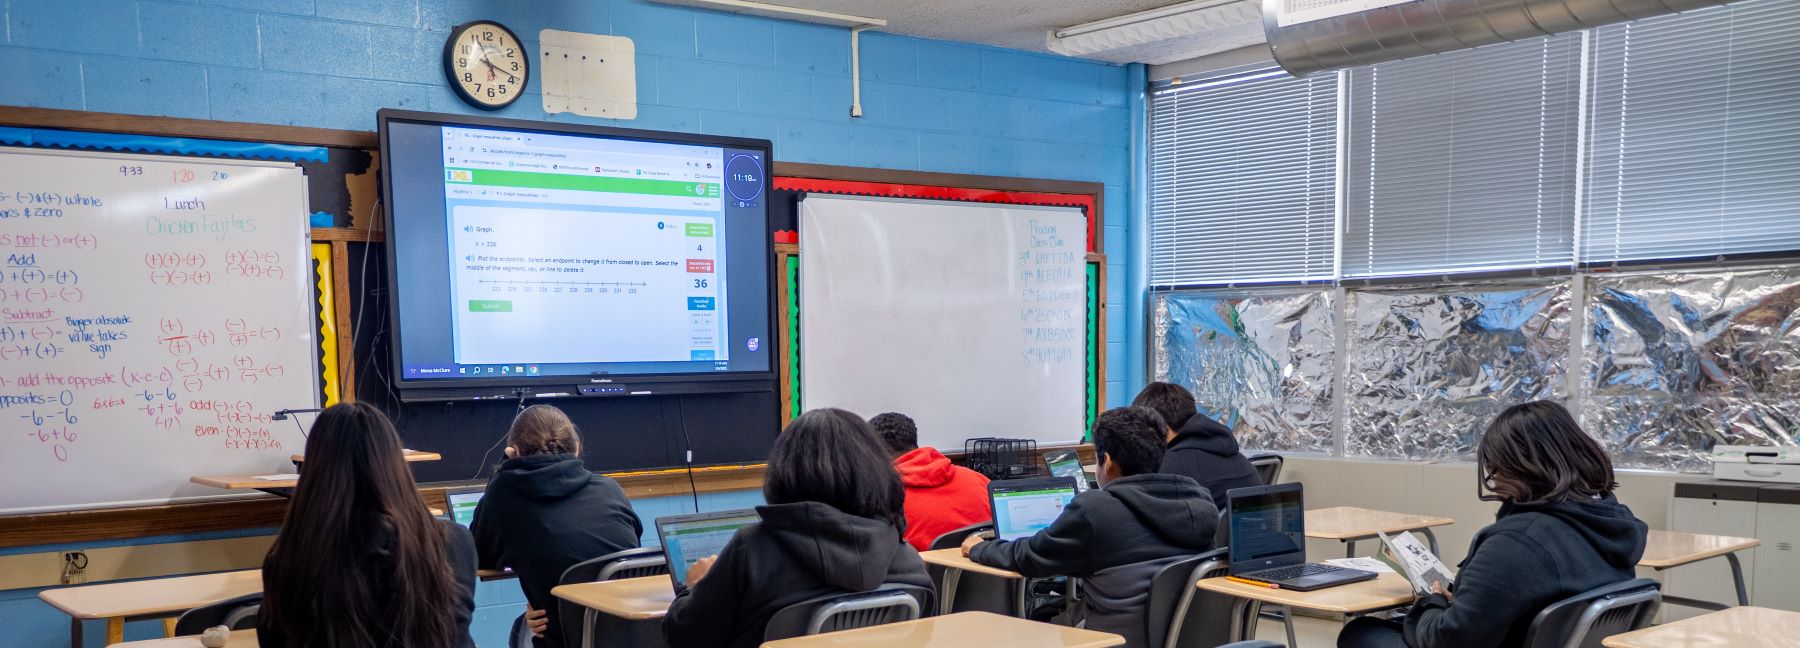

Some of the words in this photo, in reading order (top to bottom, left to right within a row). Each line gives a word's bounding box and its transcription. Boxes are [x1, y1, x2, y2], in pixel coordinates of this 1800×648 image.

[483, 32, 493, 41] 12
[506, 48, 514, 57] 2
[459, 58, 467, 67] 9
[511, 62, 518, 71] 3
[465, 73, 472, 82] 8
[508, 75, 515, 84] 4
[474, 84, 482, 92] 7
[488, 88, 495, 97] 6
[499, 85, 506, 94] 5
[65, 194, 103, 207] whole
[164, 196, 205, 210] Lunch
[16, 234, 40, 246] not
[8, 254, 35, 266] Add
[694, 279, 708, 288] 36
[2, 308, 55, 320] Subtract
[66, 315, 93, 332] Bigger
[68, 332, 94, 343] value
[96, 330, 127, 341] takes
[90, 344, 112, 359] sign
[18, 372, 40, 386] add
[44, 372, 65, 386] the
[68, 372, 116, 389] opposite
[190, 400, 211, 410] odd
